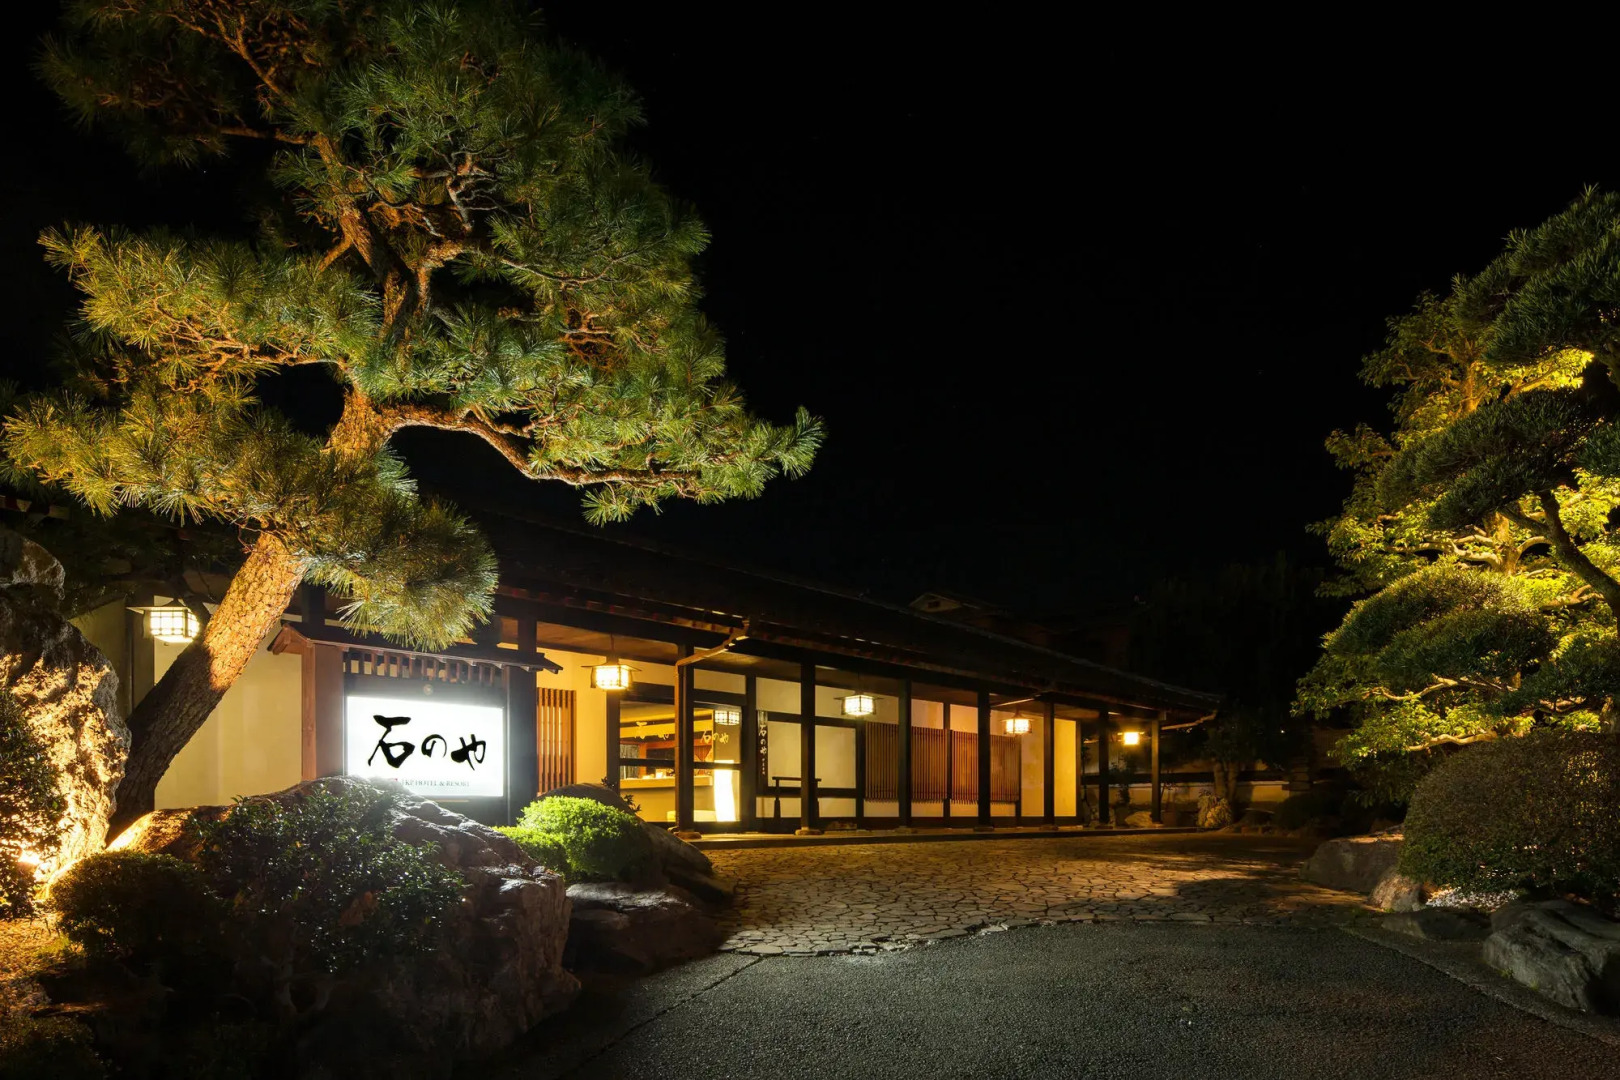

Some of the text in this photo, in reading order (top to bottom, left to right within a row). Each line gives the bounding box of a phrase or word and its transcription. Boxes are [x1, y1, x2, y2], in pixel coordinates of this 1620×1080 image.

[367, 714, 486, 771] 石のや
[415, 779, 437, 787] HOTEL
